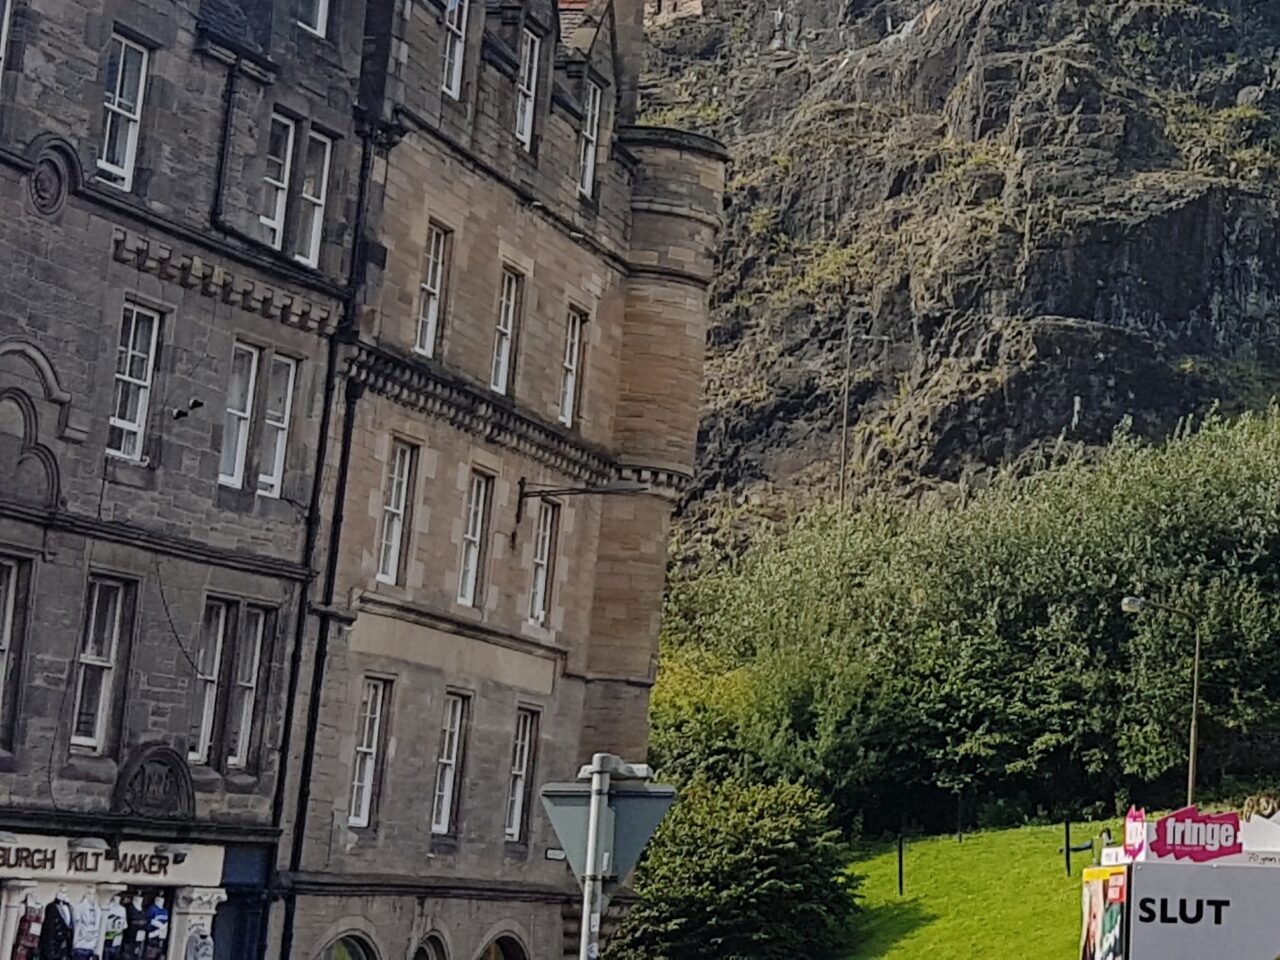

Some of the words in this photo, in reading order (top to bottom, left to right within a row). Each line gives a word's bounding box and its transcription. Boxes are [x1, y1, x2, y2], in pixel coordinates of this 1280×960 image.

[1166, 817, 1235, 851] fringe
[67, 849, 104, 874] KILT
[113, 851, 170, 876] MAKER
[1248, 853, 1259, 862] 70
[1138, 897, 1230, 925] SLUT
